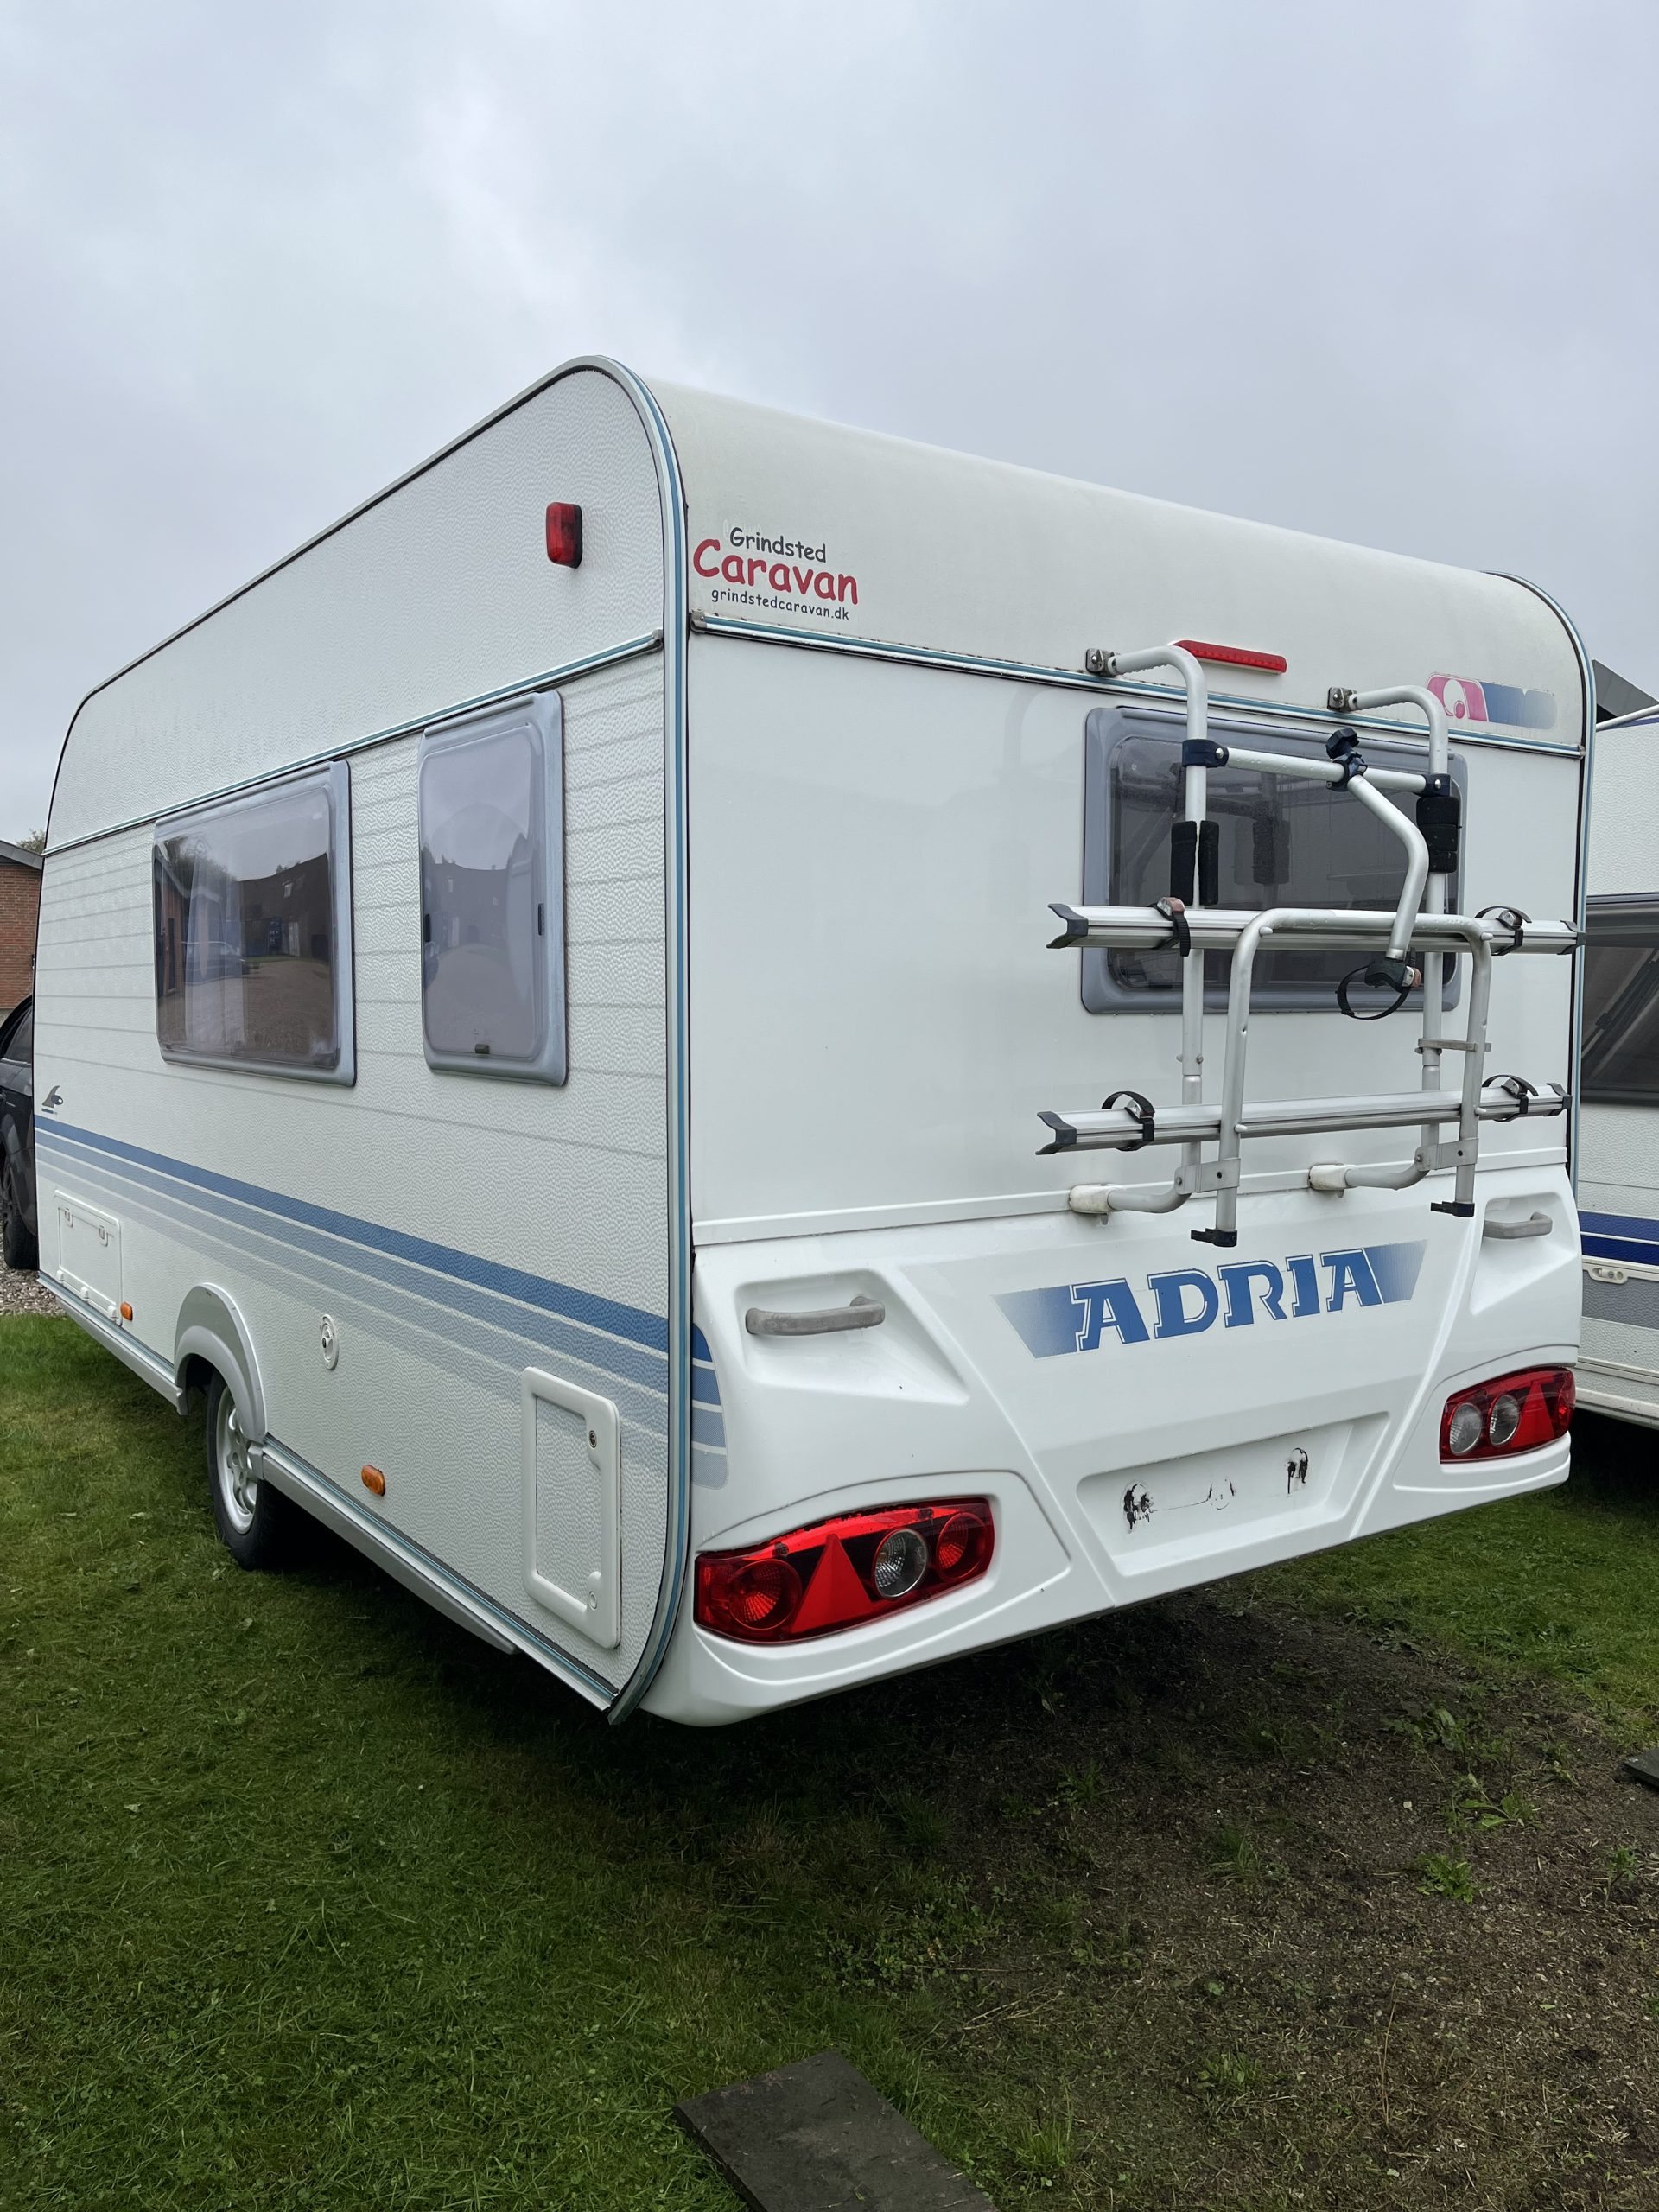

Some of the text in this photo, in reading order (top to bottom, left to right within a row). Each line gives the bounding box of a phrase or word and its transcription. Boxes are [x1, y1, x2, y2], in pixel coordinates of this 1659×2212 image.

[730, 526, 826, 563] Grindsted
[693, 538, 858, 605] Caravan
[711, 589, 849, 620] grindstedcaravan.dk
[1069, 1247, 1384, 1351] ADRIA
